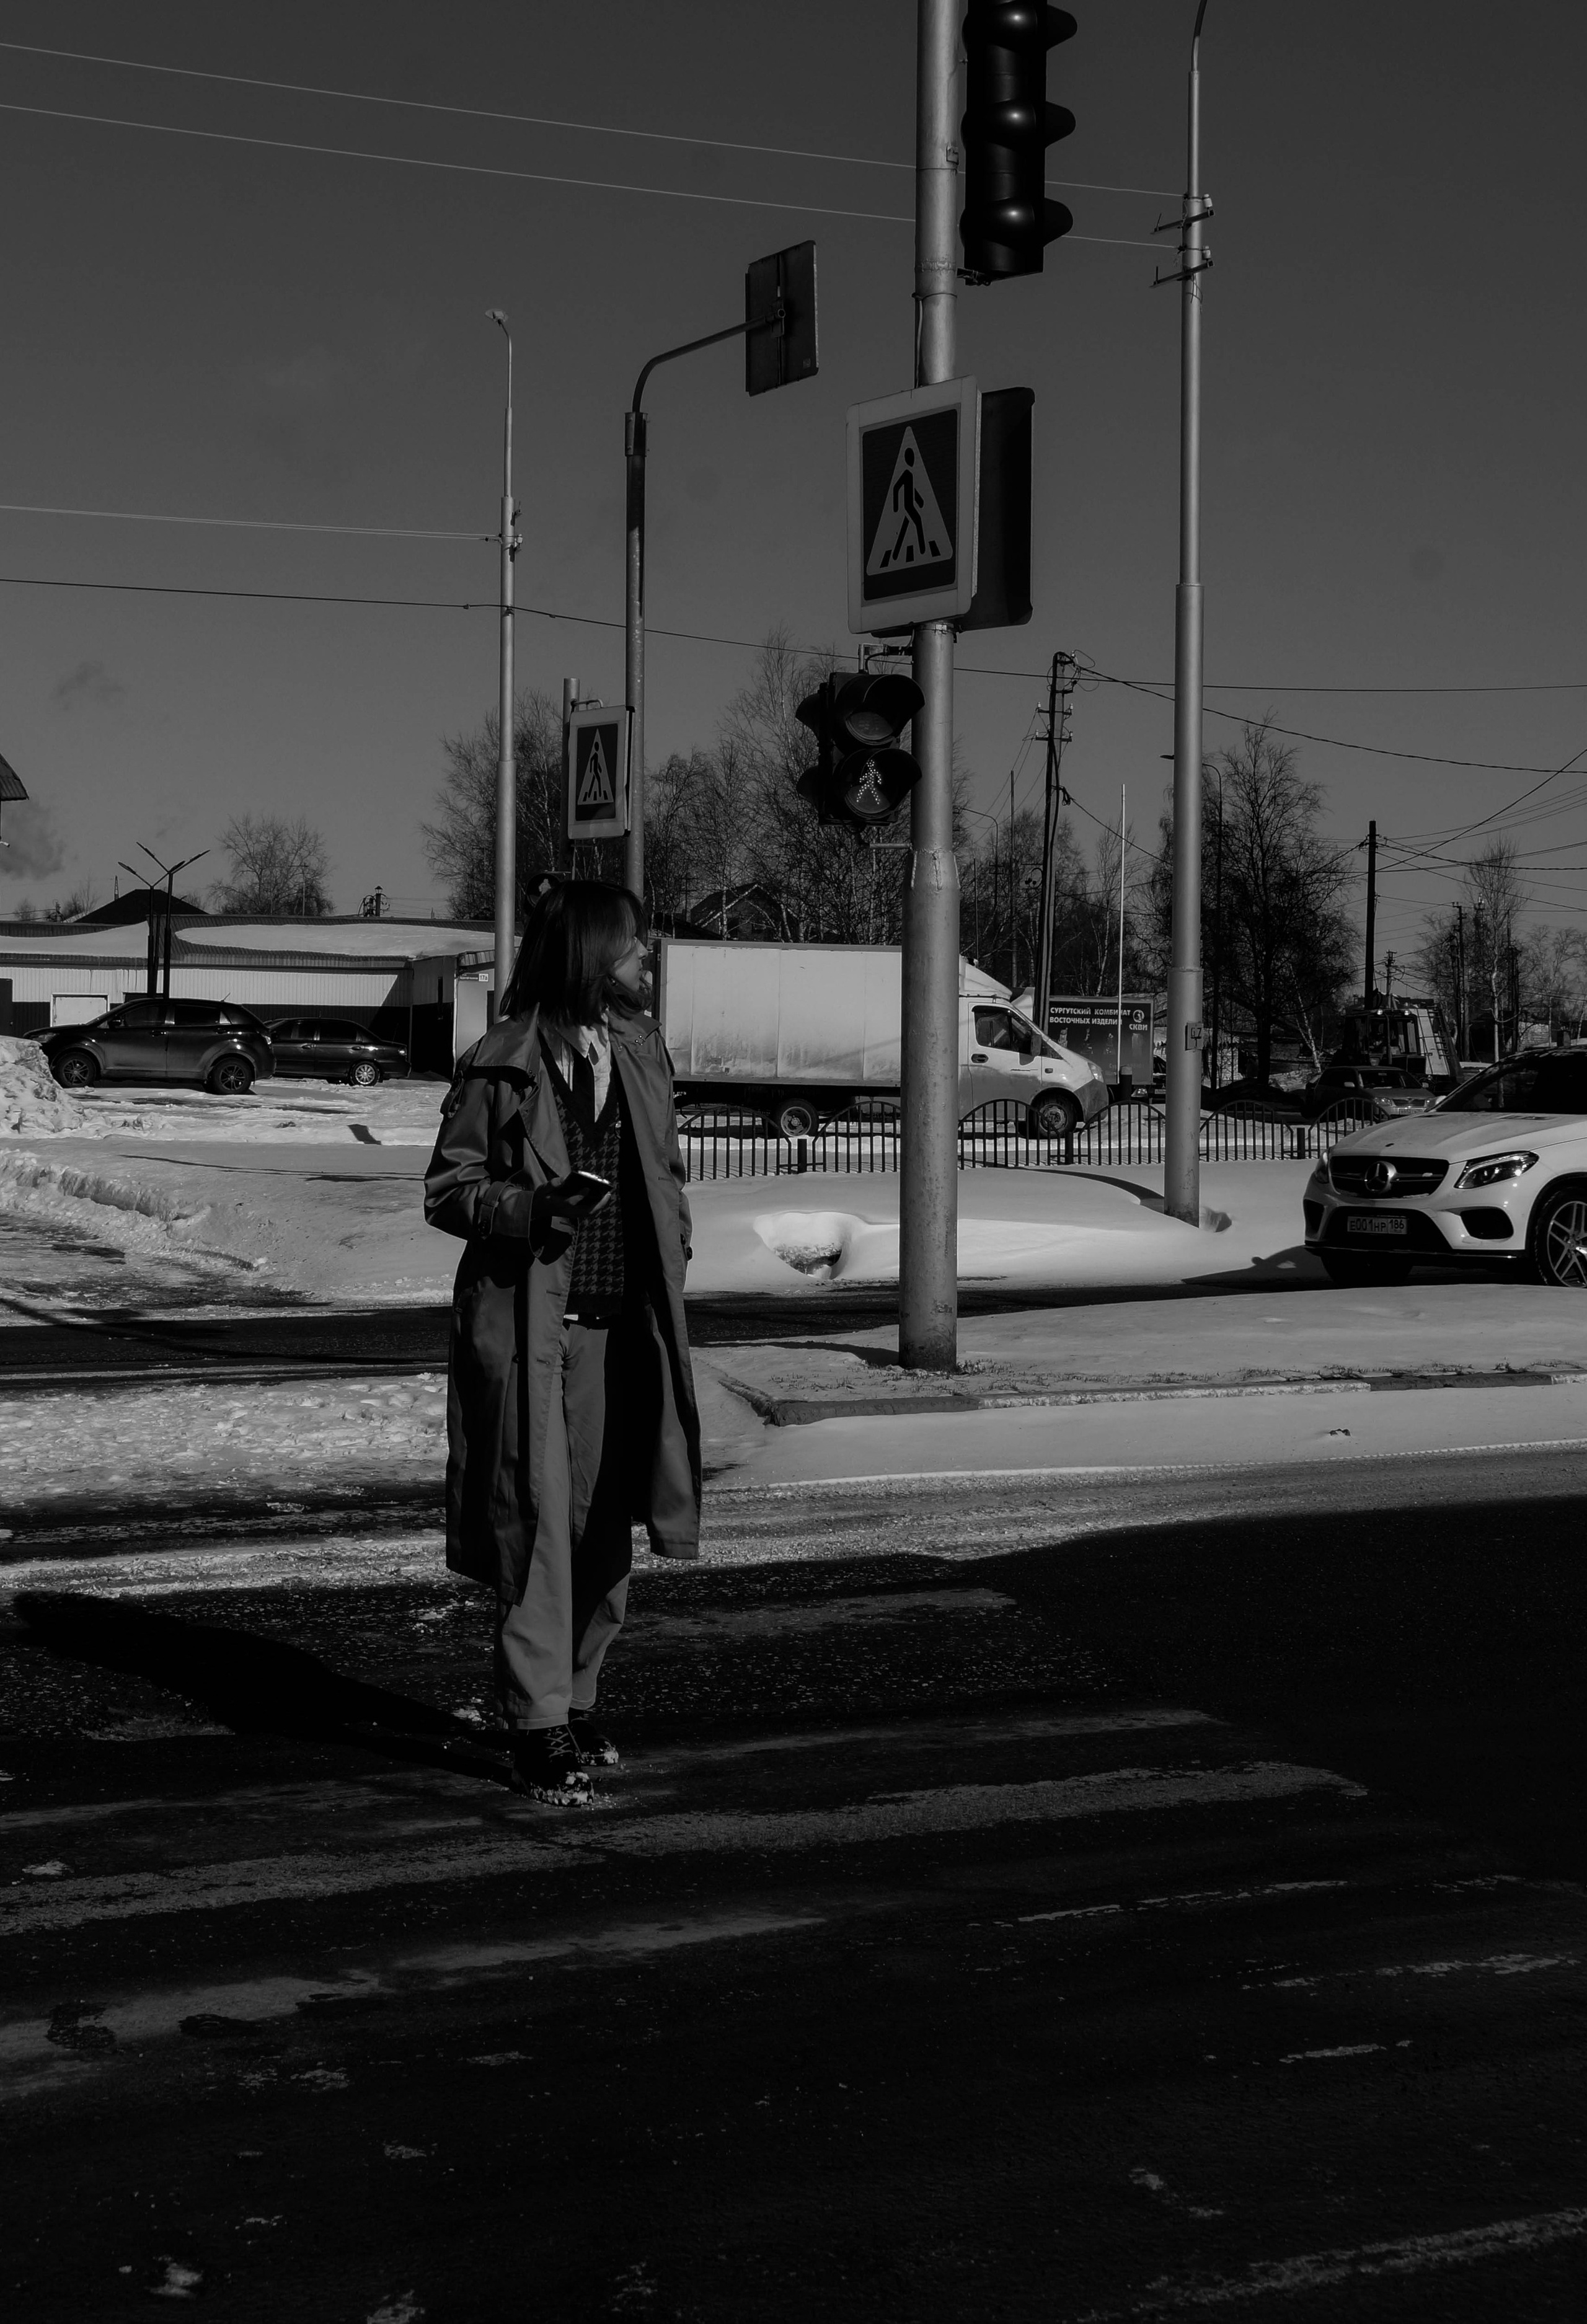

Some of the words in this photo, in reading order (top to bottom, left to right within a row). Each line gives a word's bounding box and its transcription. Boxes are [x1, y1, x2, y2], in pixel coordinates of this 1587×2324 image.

[1050, 1007, 1091, 1015] СУРГУТСКИЙ
[1049, 1017, 1090, 1025] ВОСТОЧНЫХ
[1389, 1219, 1405, 1229] 186
